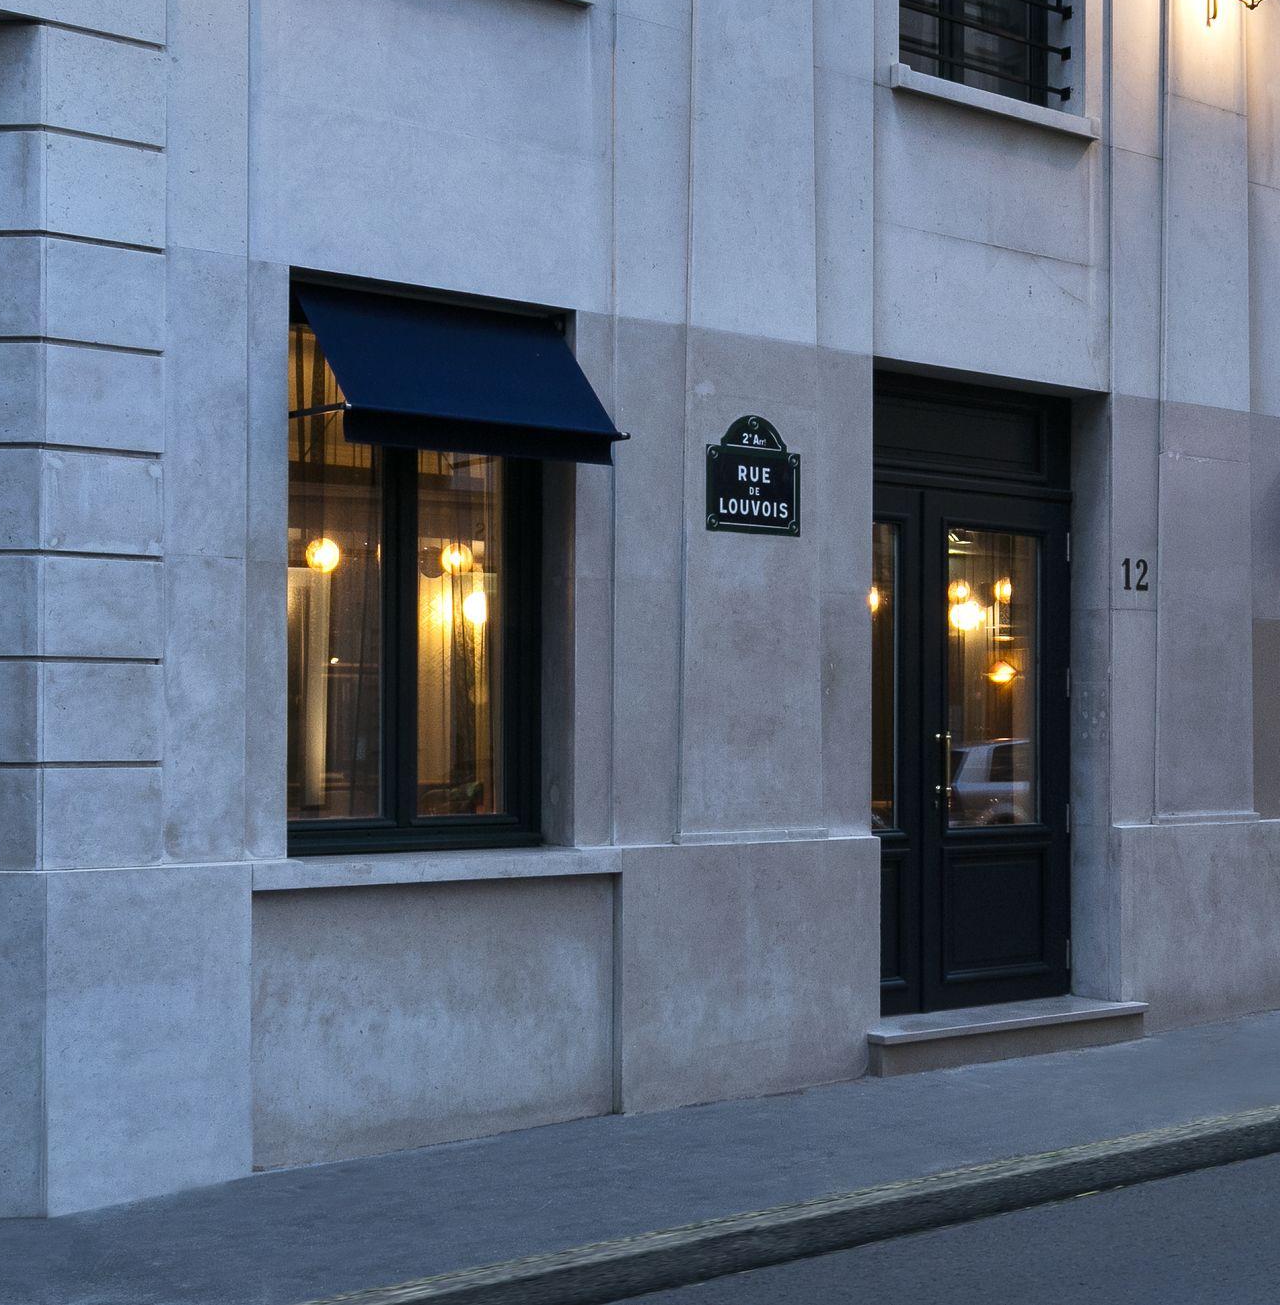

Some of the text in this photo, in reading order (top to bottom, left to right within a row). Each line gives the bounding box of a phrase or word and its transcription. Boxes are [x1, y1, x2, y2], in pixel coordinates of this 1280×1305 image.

[737, 465, 771, 484] RUE
[749, 486, 760, 496] DE
[719, 497, 789, 519] LOUVOIS
[1121, 557, 1149, 591] 12
